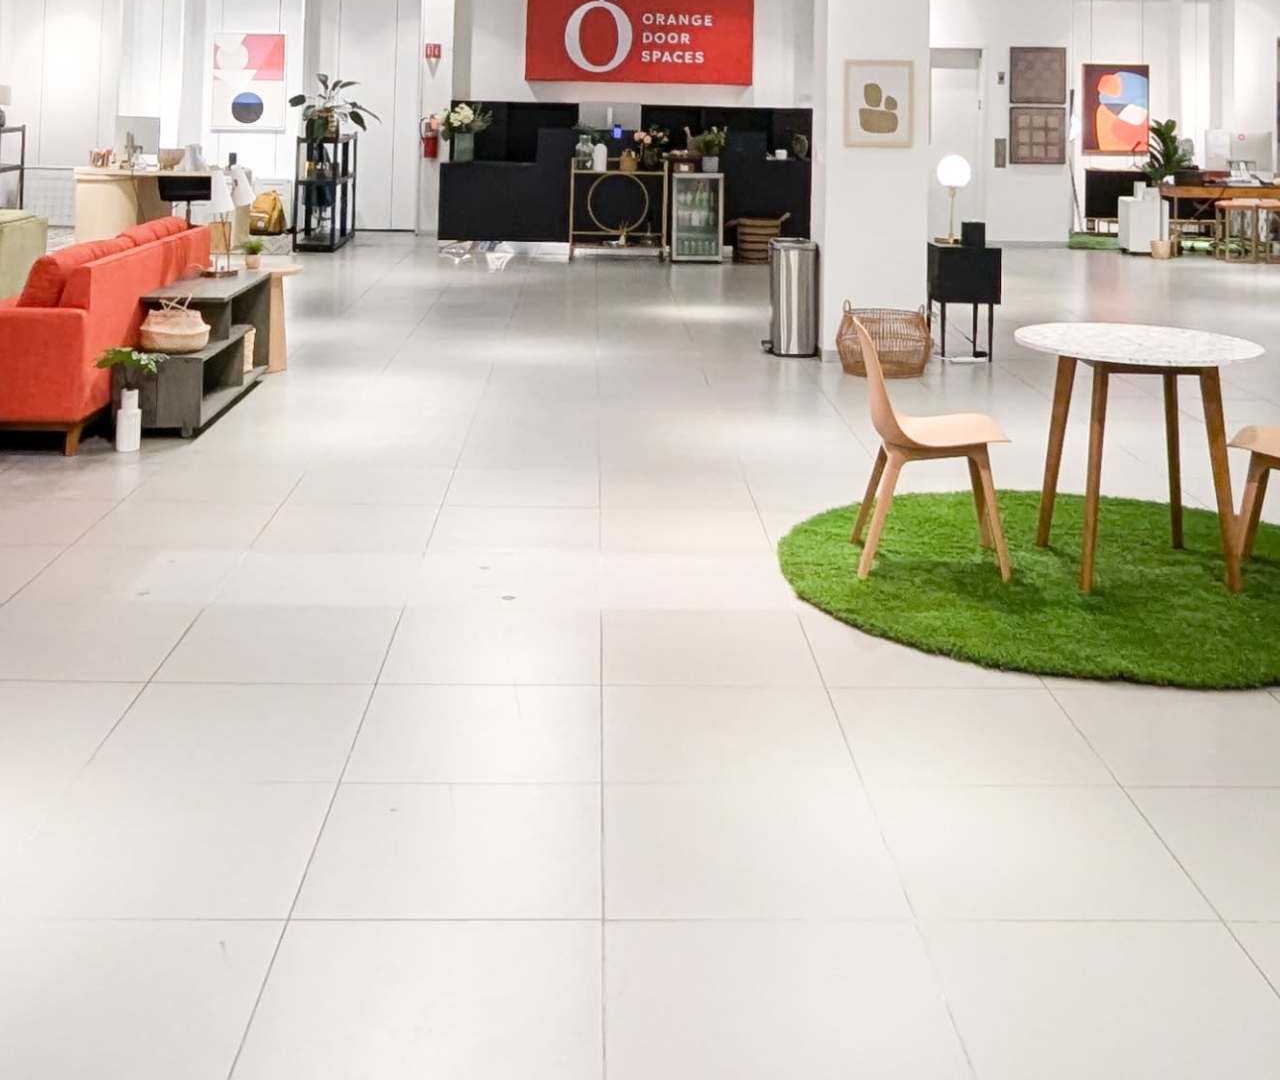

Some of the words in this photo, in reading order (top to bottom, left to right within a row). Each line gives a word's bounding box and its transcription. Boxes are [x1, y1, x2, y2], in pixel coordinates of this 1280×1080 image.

[642, 12, 713, 27] ORANGE
[642, 31, 691, 45] DOOR
[641, 50, 705, 64] SPACES
